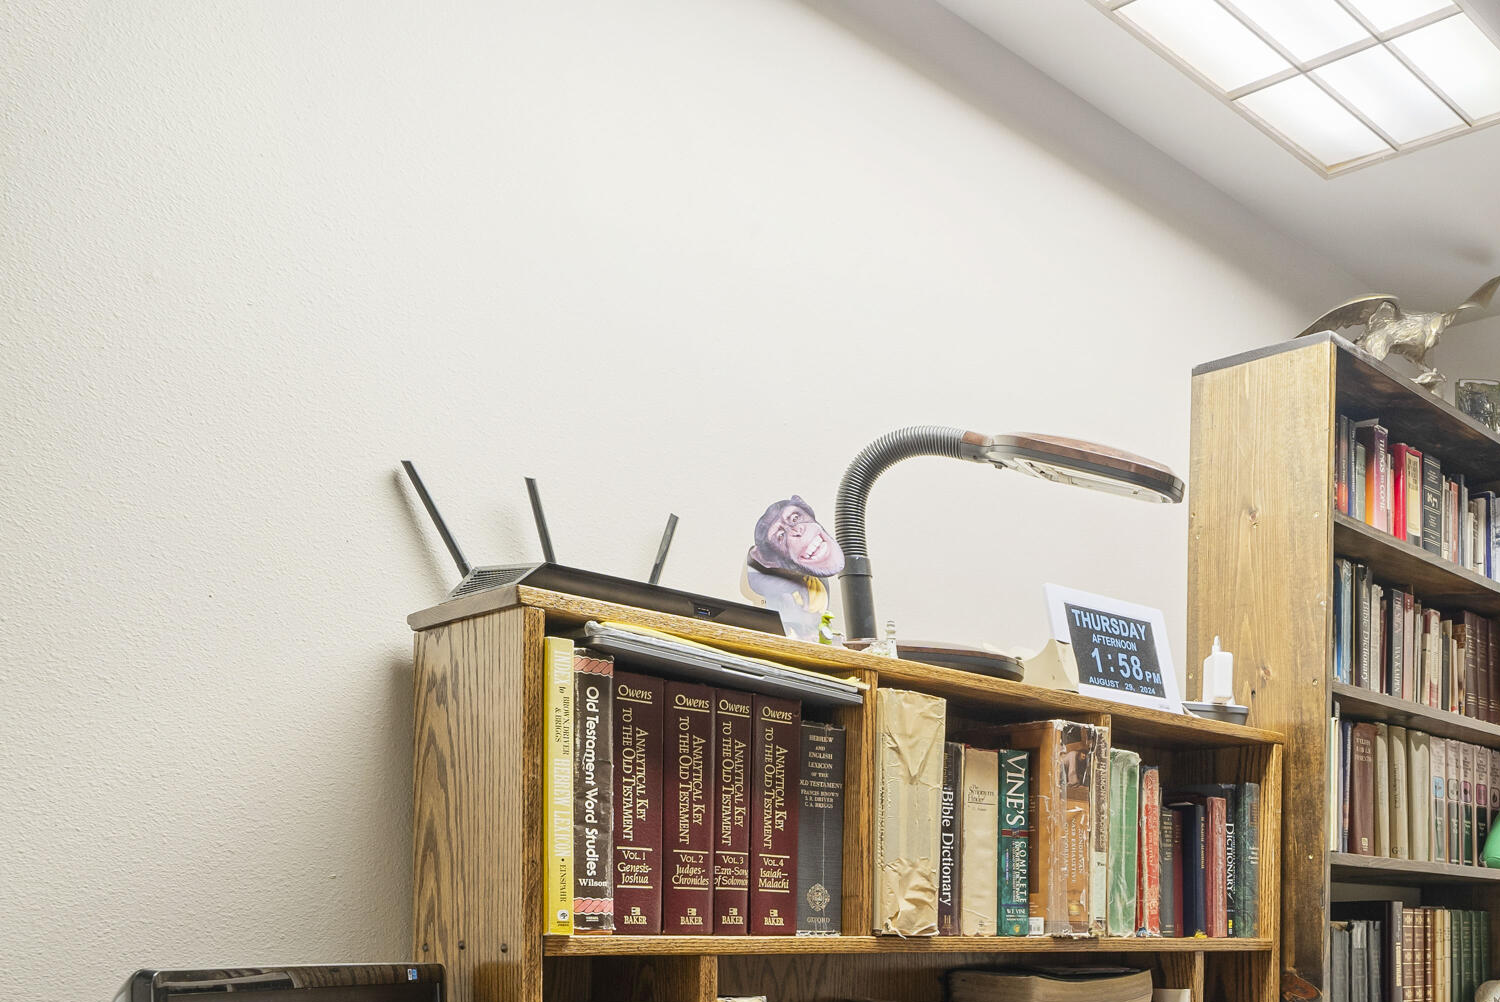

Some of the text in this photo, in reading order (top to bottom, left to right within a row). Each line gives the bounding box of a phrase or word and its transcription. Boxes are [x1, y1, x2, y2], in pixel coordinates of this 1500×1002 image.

[1071, 608, 1146, 641] THURSDAY
[1092, 633, 1137, 652] AFTERNOON
[1361, 630, 1369, 683] Dictionary
[553, 650, 571, 694] INDEX to
[1145, 671, 1162, 685] PM
[618, 685, 652, 700] Owens
[1089, 676, 1119, 689] AUGUST
[1140, 685, 1156, 695] 2024
[675, 694, 710, 709] Owens
[719, 699, 751, 715] Owens
[762, 706, 793, 721] Owens
[554, 714, 562, 743] BRIGGS
[562, 727, 570, 756] DRIVER
[808, 735, 834, 743] HEBREW
[808, 752, 833, 760] ENGLISH
[808, 761, 833, 769] LEXICON
[585, 686, 599, 877] Old Testament Word Studies
[622, 707, 636, 842] TO THE OLD TESTAMENT
[636, 727, 649, 822] ANALYTICAL KEY
[679, 716, 693, 845] TO THE OLD TESTAMENT
[692, 734, 706, 826] ANALYTICAL KEY
[721, 721, 735, 847] TO THE OLD TESTAMENT
[735, 739, 747, 828] ANALYTICAL KEY
[763, 728, 777, 849] TO THE OLD TESTAMENT
[775, 745, 789, 832] ANALYTICAL KEY
[809, 780, 843, 789] TESTAMENT
[553, 758, 571, 857] HEBREW LEXICON
[942, 790, 954, 827] Bible
[622, 851, 646, 861] VOL. 1
[680, 854, 704, 864] VOL. 2
[722, 855, 745, 865] VOL. 3
[762, 857, 785, 868] VOL. 4
[1225, 822, 1235, 892] DICTIONARY
[617, 863, 652, 874] Genesis-
[675, 864, 706, 876] Judges-
[940, 833, 954, 906] Dictionary
[1019, 841, 1027, 904] COMPLETE
[559, 864, 567, 903] EINSPAHR
[578, 879, 608, 888] Wilson
[622, 873, 649, 884] Joshua
[672, 875, 710, 886] Chronicles
[759, 876, 789, 890] Malachi
[624, 915, 648, 925] BAKER
[680, 916, 704, 925] BAKER
[722, 916, 744, 925] BAKER
[764, 917, 785, 926] BAKER
